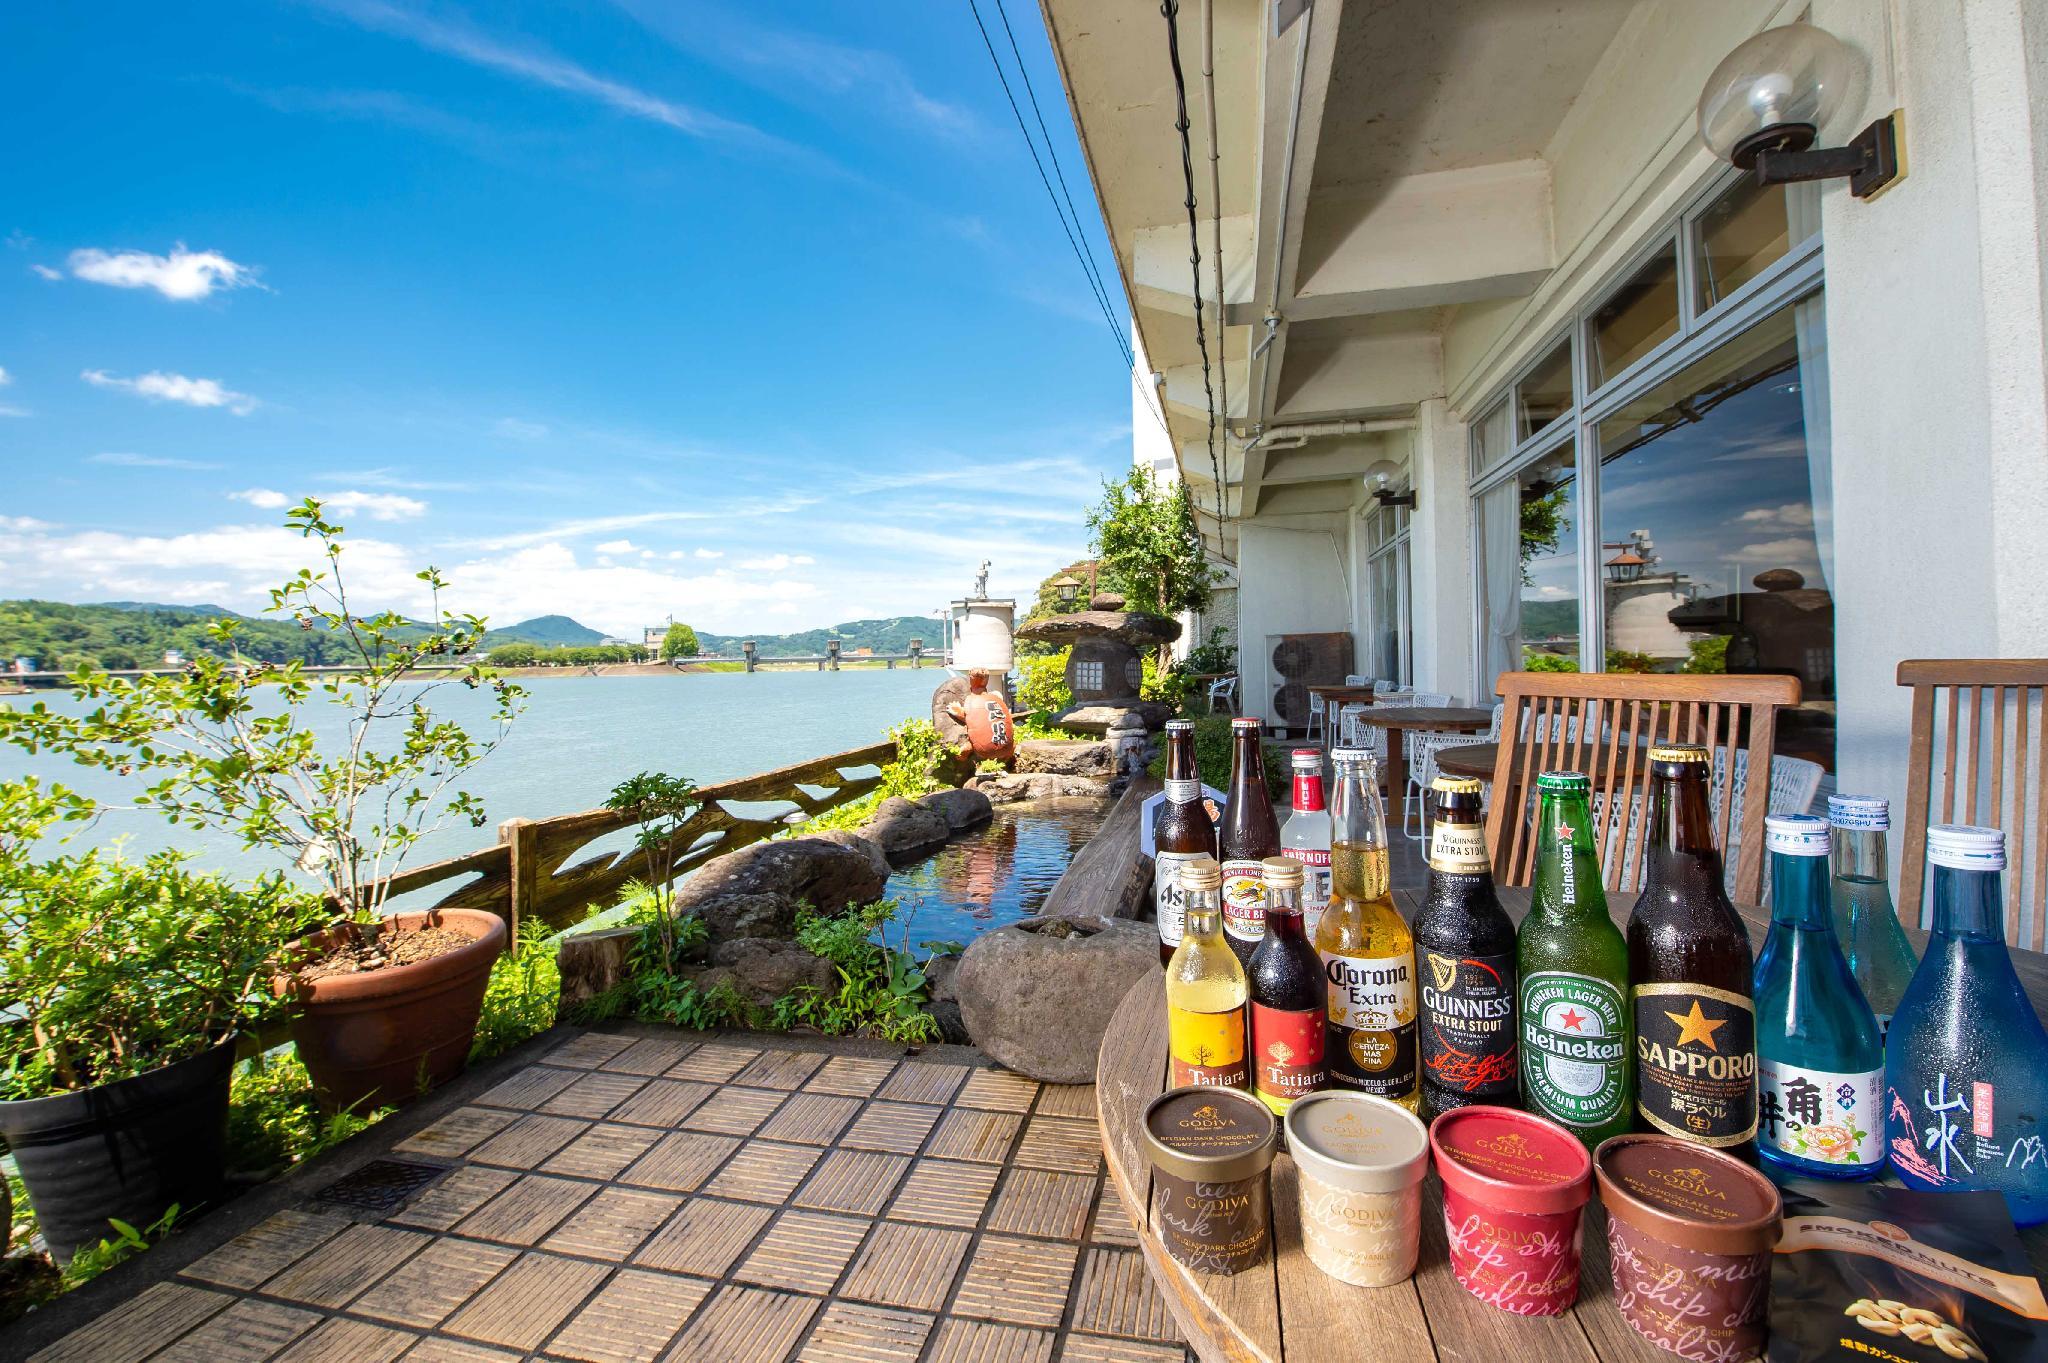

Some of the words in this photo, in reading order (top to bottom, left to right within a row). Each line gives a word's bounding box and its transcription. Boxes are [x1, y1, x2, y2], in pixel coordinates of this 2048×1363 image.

[1436, 845, 1462, 856] EXTRA
[1449, 835, 1481, 845] GUINNESS
[1560, 843, 1576, 905] Heineken
[1224, 902, 1251, 919] LAGER
[1326, 960, 1408, 990] Corona
[1348, 986, 1397, 1005] Extra
[1423, 985, 1511, 1018] GUINNESS
[1529, 987, 1565, 1015] HEINEKEN
[1567, 988, 1602, 1007] LAGER
[1600, 1002, 1617, 1025] BEER
[1432, 1011, 1466, 1031] EXTRA
[1469, 1019, 1503, 1032] STOUT
[1353, 1042, 1390, 1050] CERVEZA
[1525, 1022, 1624, 1060] Heineken
[1363, 1057, 1382, 1065] FINA
[1637, 1035, 1754, 1080] SAPPORO
[1188, 1068, 1245, 1087] Tatiara
[1266, 1066, 1325, 1087] Tatiara
[1365, 1086, 1386, 1094] MEXICO
[1532, 1065, 1576, 1110] PREMIUM
[1580, 1079, 1619, 1111] QUALITY
[1670, 1089, 1727, 1106] サッポロ生ビール
[1840, 1086, 1852, 1107] 冷酒
[1670, 1097, 1727, 1119] 黒ラベル
[1924, 1072, 1975, 1175] 山水
[1476, 1139, 1545, 1161] GODIVA
[1443, 1145, 1497, 1164] STRAWBERRY
[1498, 1161, 1550, 1177] CHOCOLATE
[1550, 1173, 1572, 1181] CHIP
[1648, 1169, 1726, 1201] GODIVA
[1185, 1194, 1249, 1210] GODIVA
[1624, 1176, 1647, 1189] MILK
[1649, 1186, 1709, 1210] CHOCOLATE
[1713, 1207, 1739, 1217] CHIP
[1331, 1204, 1396, 1221] GODIVA
[1228, 1227, 1265, 1251] CHOCOLATE
[1800, 1224, 1913, 1254] SMOKED
[1919, 1252, 1997, 1288] NUTS
[1636, 1268, 1711, 1332] chip
[1711, 1329, 1735, 1337] CHIP
